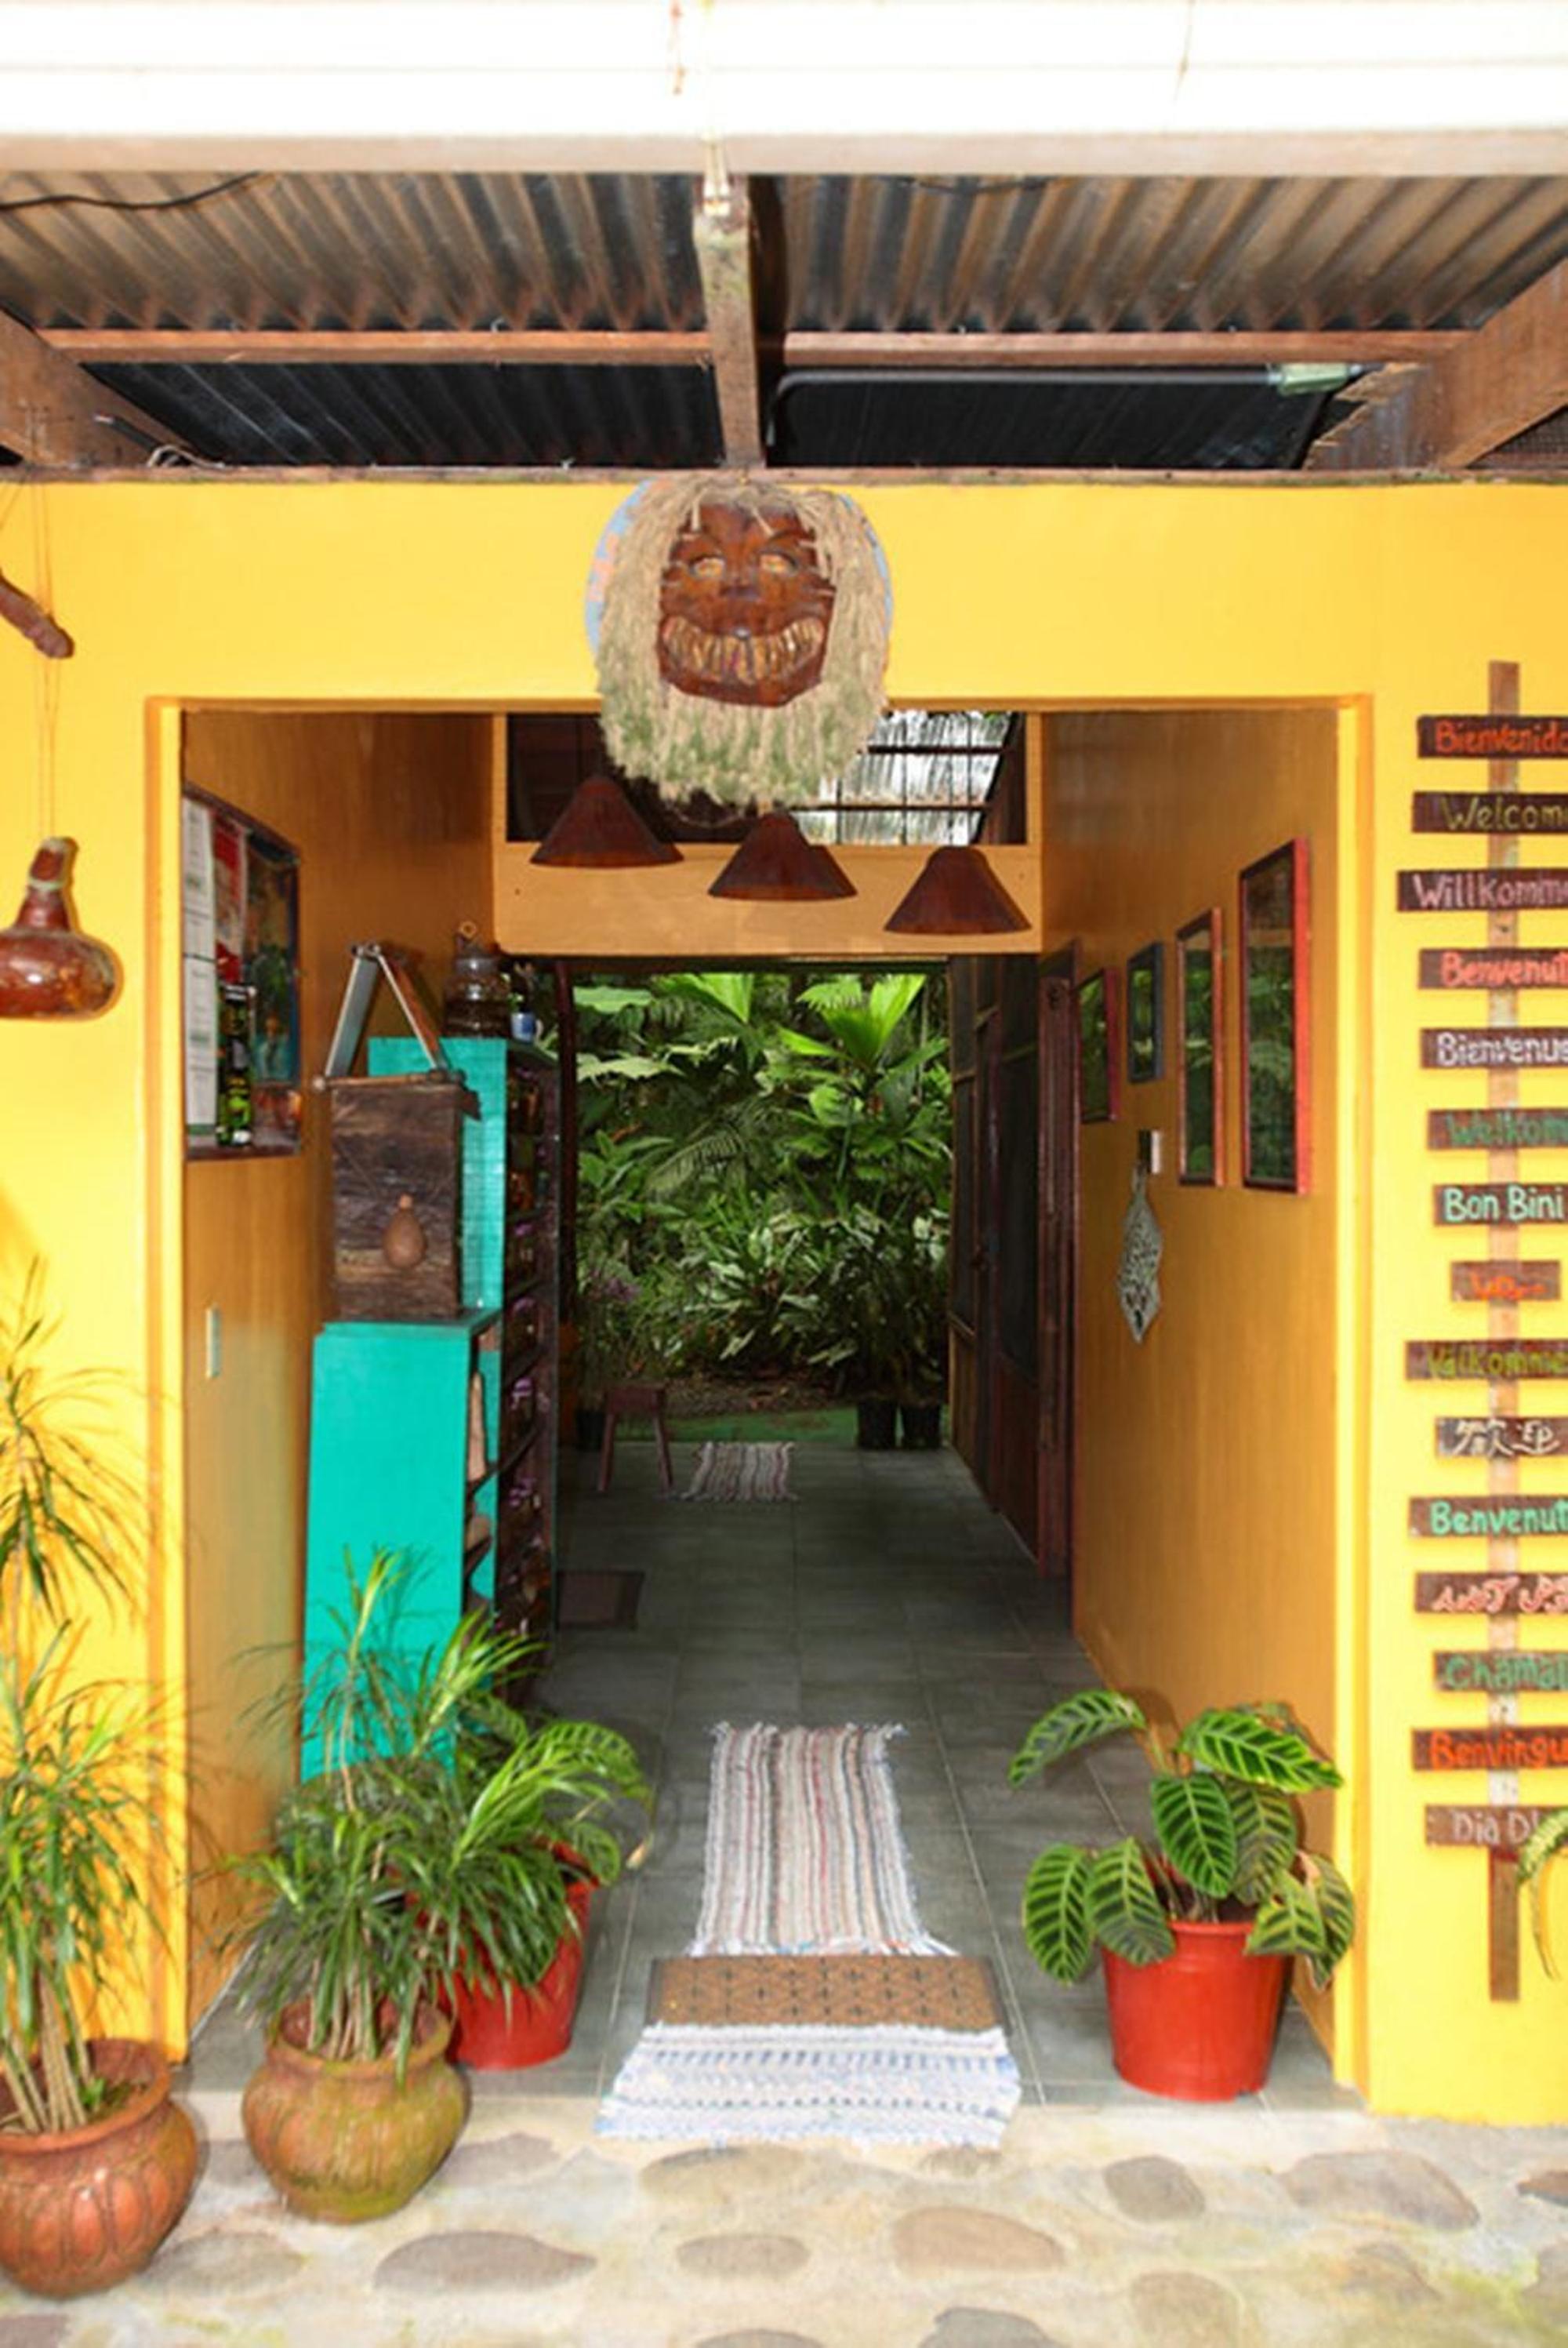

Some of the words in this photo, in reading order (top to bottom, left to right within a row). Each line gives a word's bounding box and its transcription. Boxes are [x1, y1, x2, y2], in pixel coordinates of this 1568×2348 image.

[1439, 795, 1568, 831] Welcom
[1414, 872, 1568, 908] Willkomm
[1443, 1187, 1499, 1222] Bon
[1508, 1184, 1564, 1222] Bini
